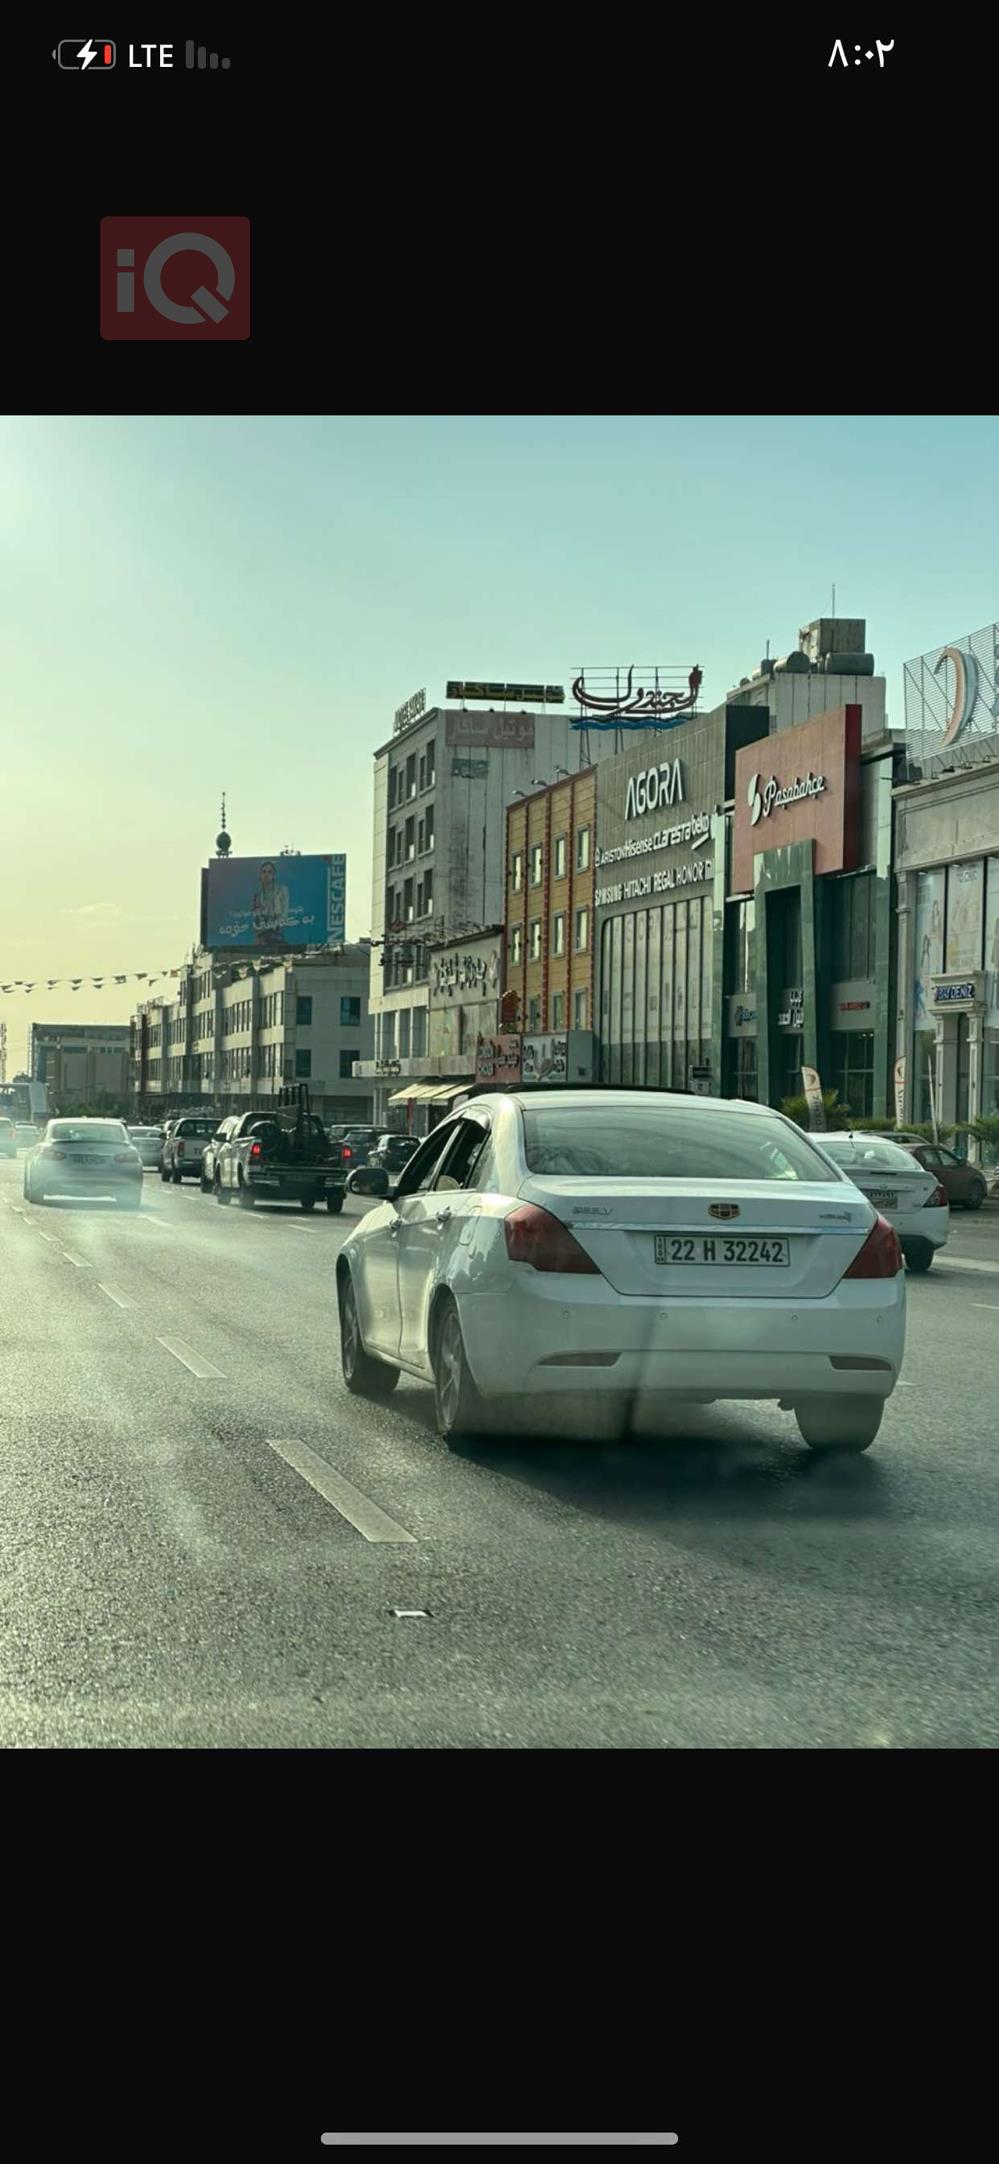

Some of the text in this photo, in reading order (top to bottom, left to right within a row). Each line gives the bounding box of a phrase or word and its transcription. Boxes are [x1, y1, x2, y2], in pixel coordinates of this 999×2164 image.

[624, 758, 683, 820] AGORA
[625, 837, 653, 857] Hisense
[595, 884, 622, 906] SAMSUNG
[623, 874, 651, 899] HITACHI
[653, 867, 675, 893] REGAL
[676, 861, 703, 886] HONOR
[671, 1239, 784, 1263] 22 H 32242
